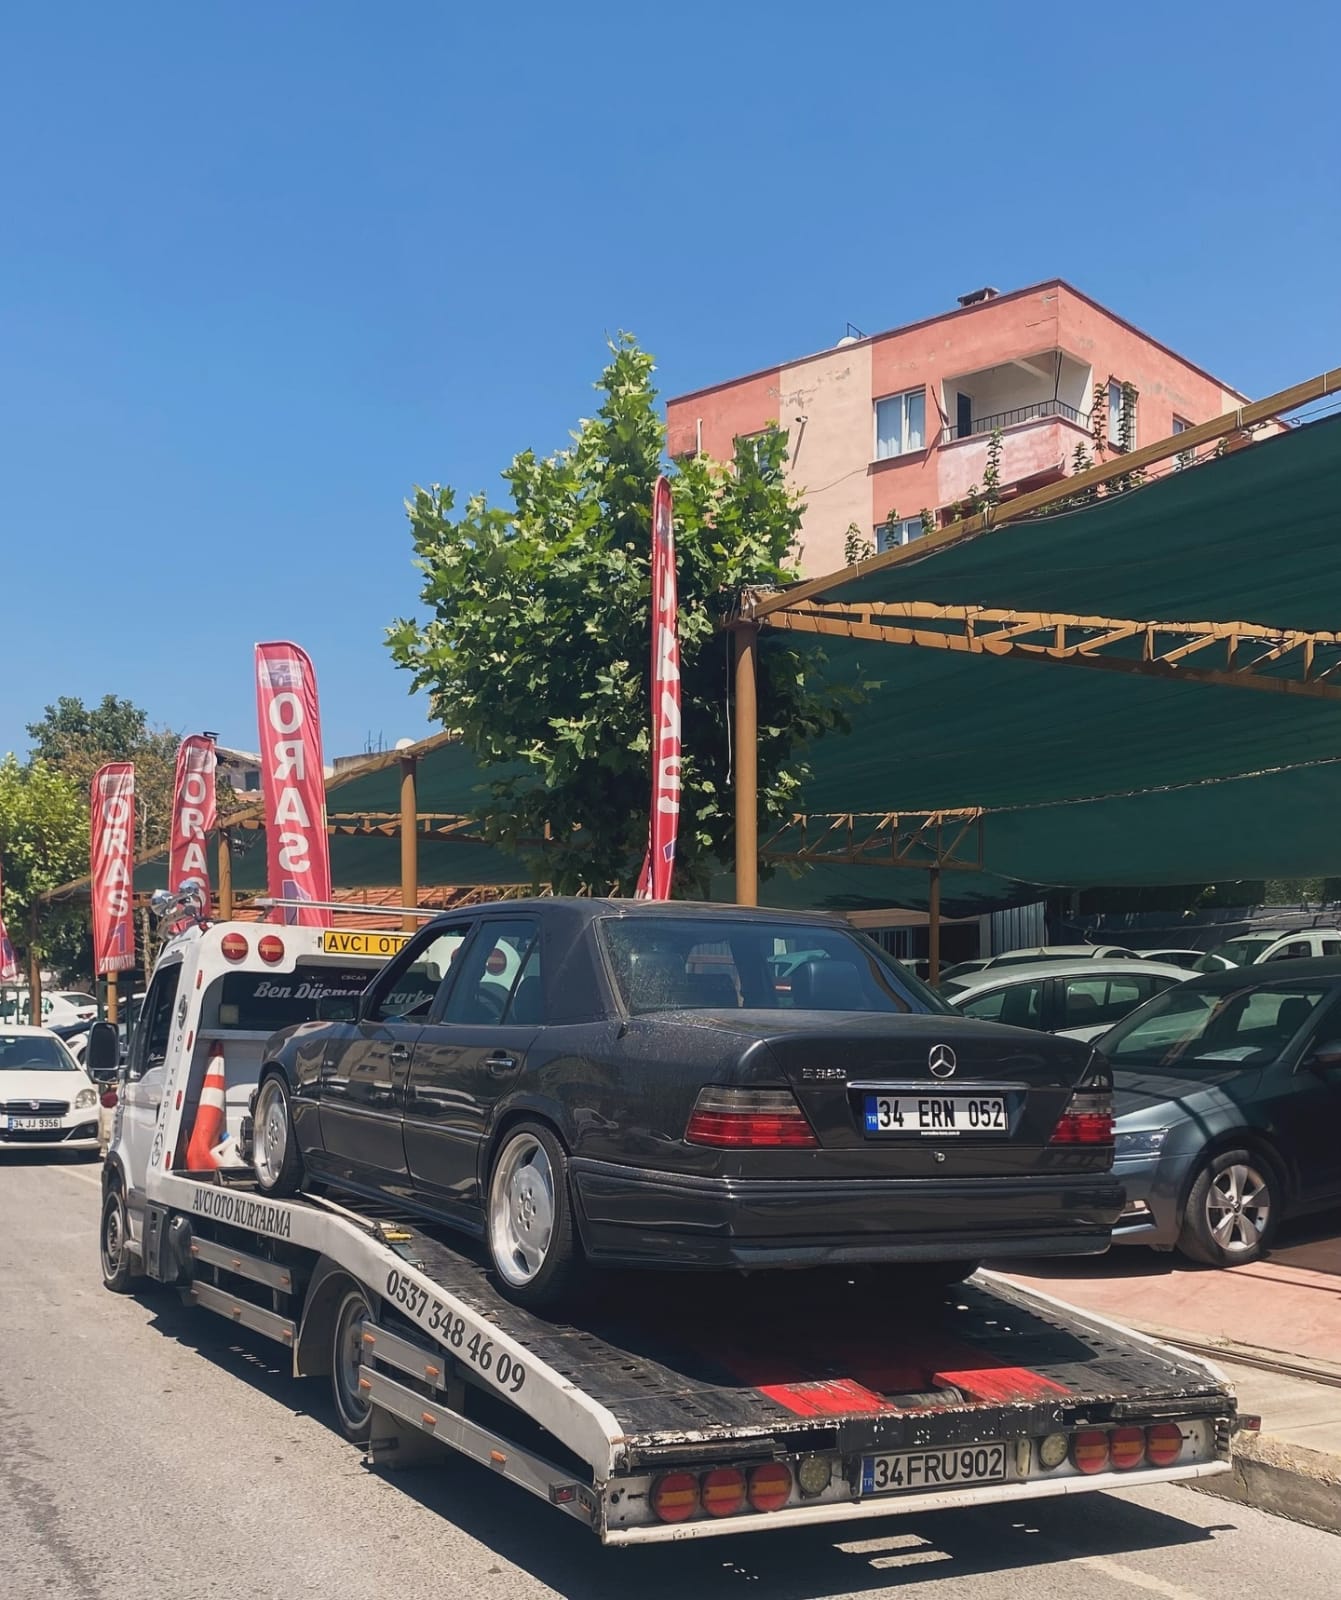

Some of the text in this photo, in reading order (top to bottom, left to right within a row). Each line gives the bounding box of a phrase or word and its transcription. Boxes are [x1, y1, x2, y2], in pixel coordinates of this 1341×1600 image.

[102, 797, 131, 918] ORAS
[328, 935, 369, 952] AVCI
[253, 982, 292, 998] Ben
[867, 1115, 877, 1124] TR
[879, 1100, 1002, 1127] 34 ERN 052
[193, 1188, 291, 1238] AVCI OTO KURTARMA
[387, 1269, 525, 1393] 0537 348 46 09
